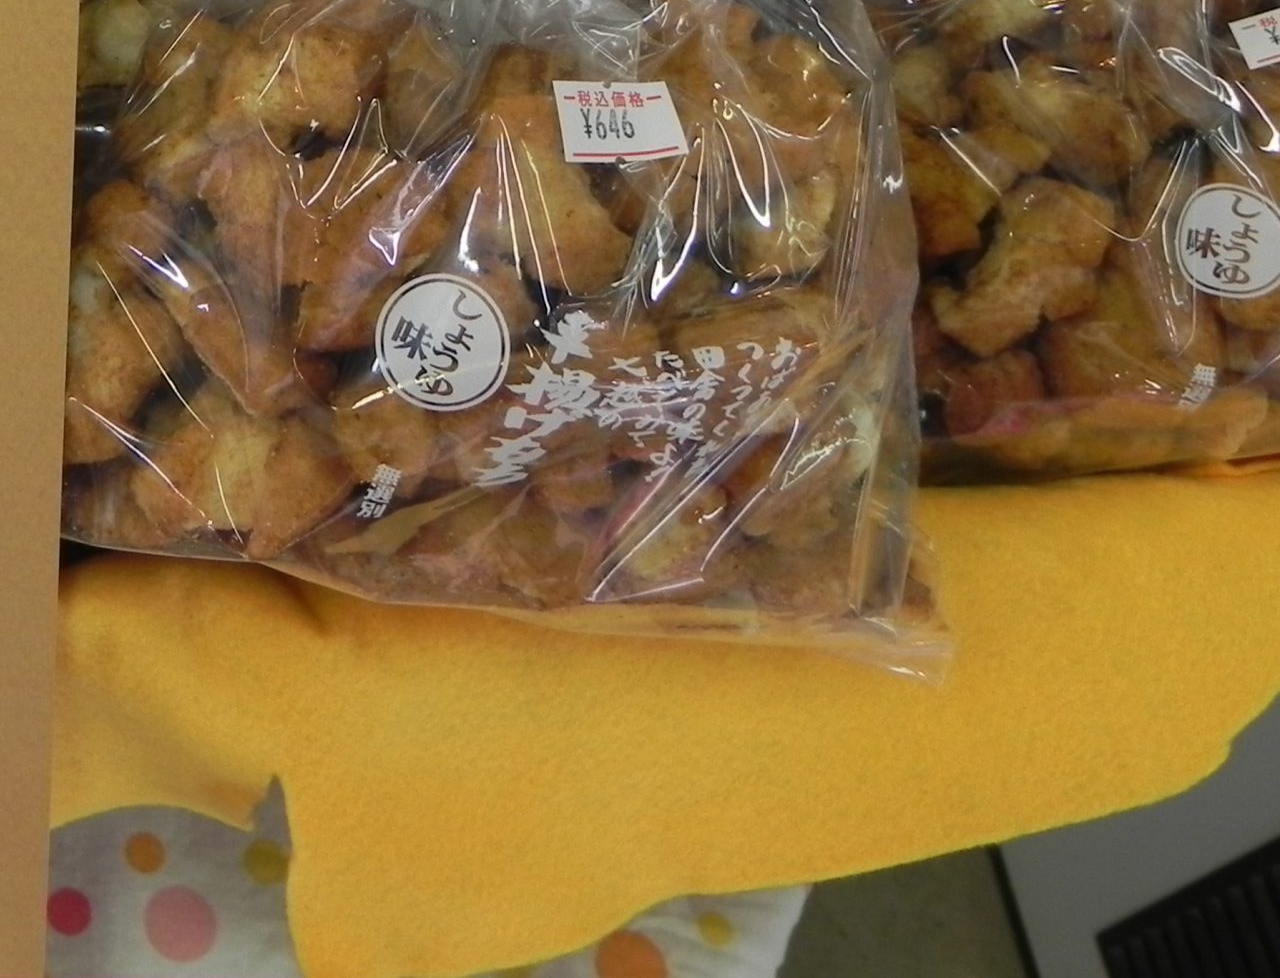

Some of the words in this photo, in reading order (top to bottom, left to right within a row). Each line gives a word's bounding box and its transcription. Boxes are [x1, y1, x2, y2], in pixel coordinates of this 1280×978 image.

[577, 90, 644, 108] 税込価格
[580, 108, 636, 140] ¥646
